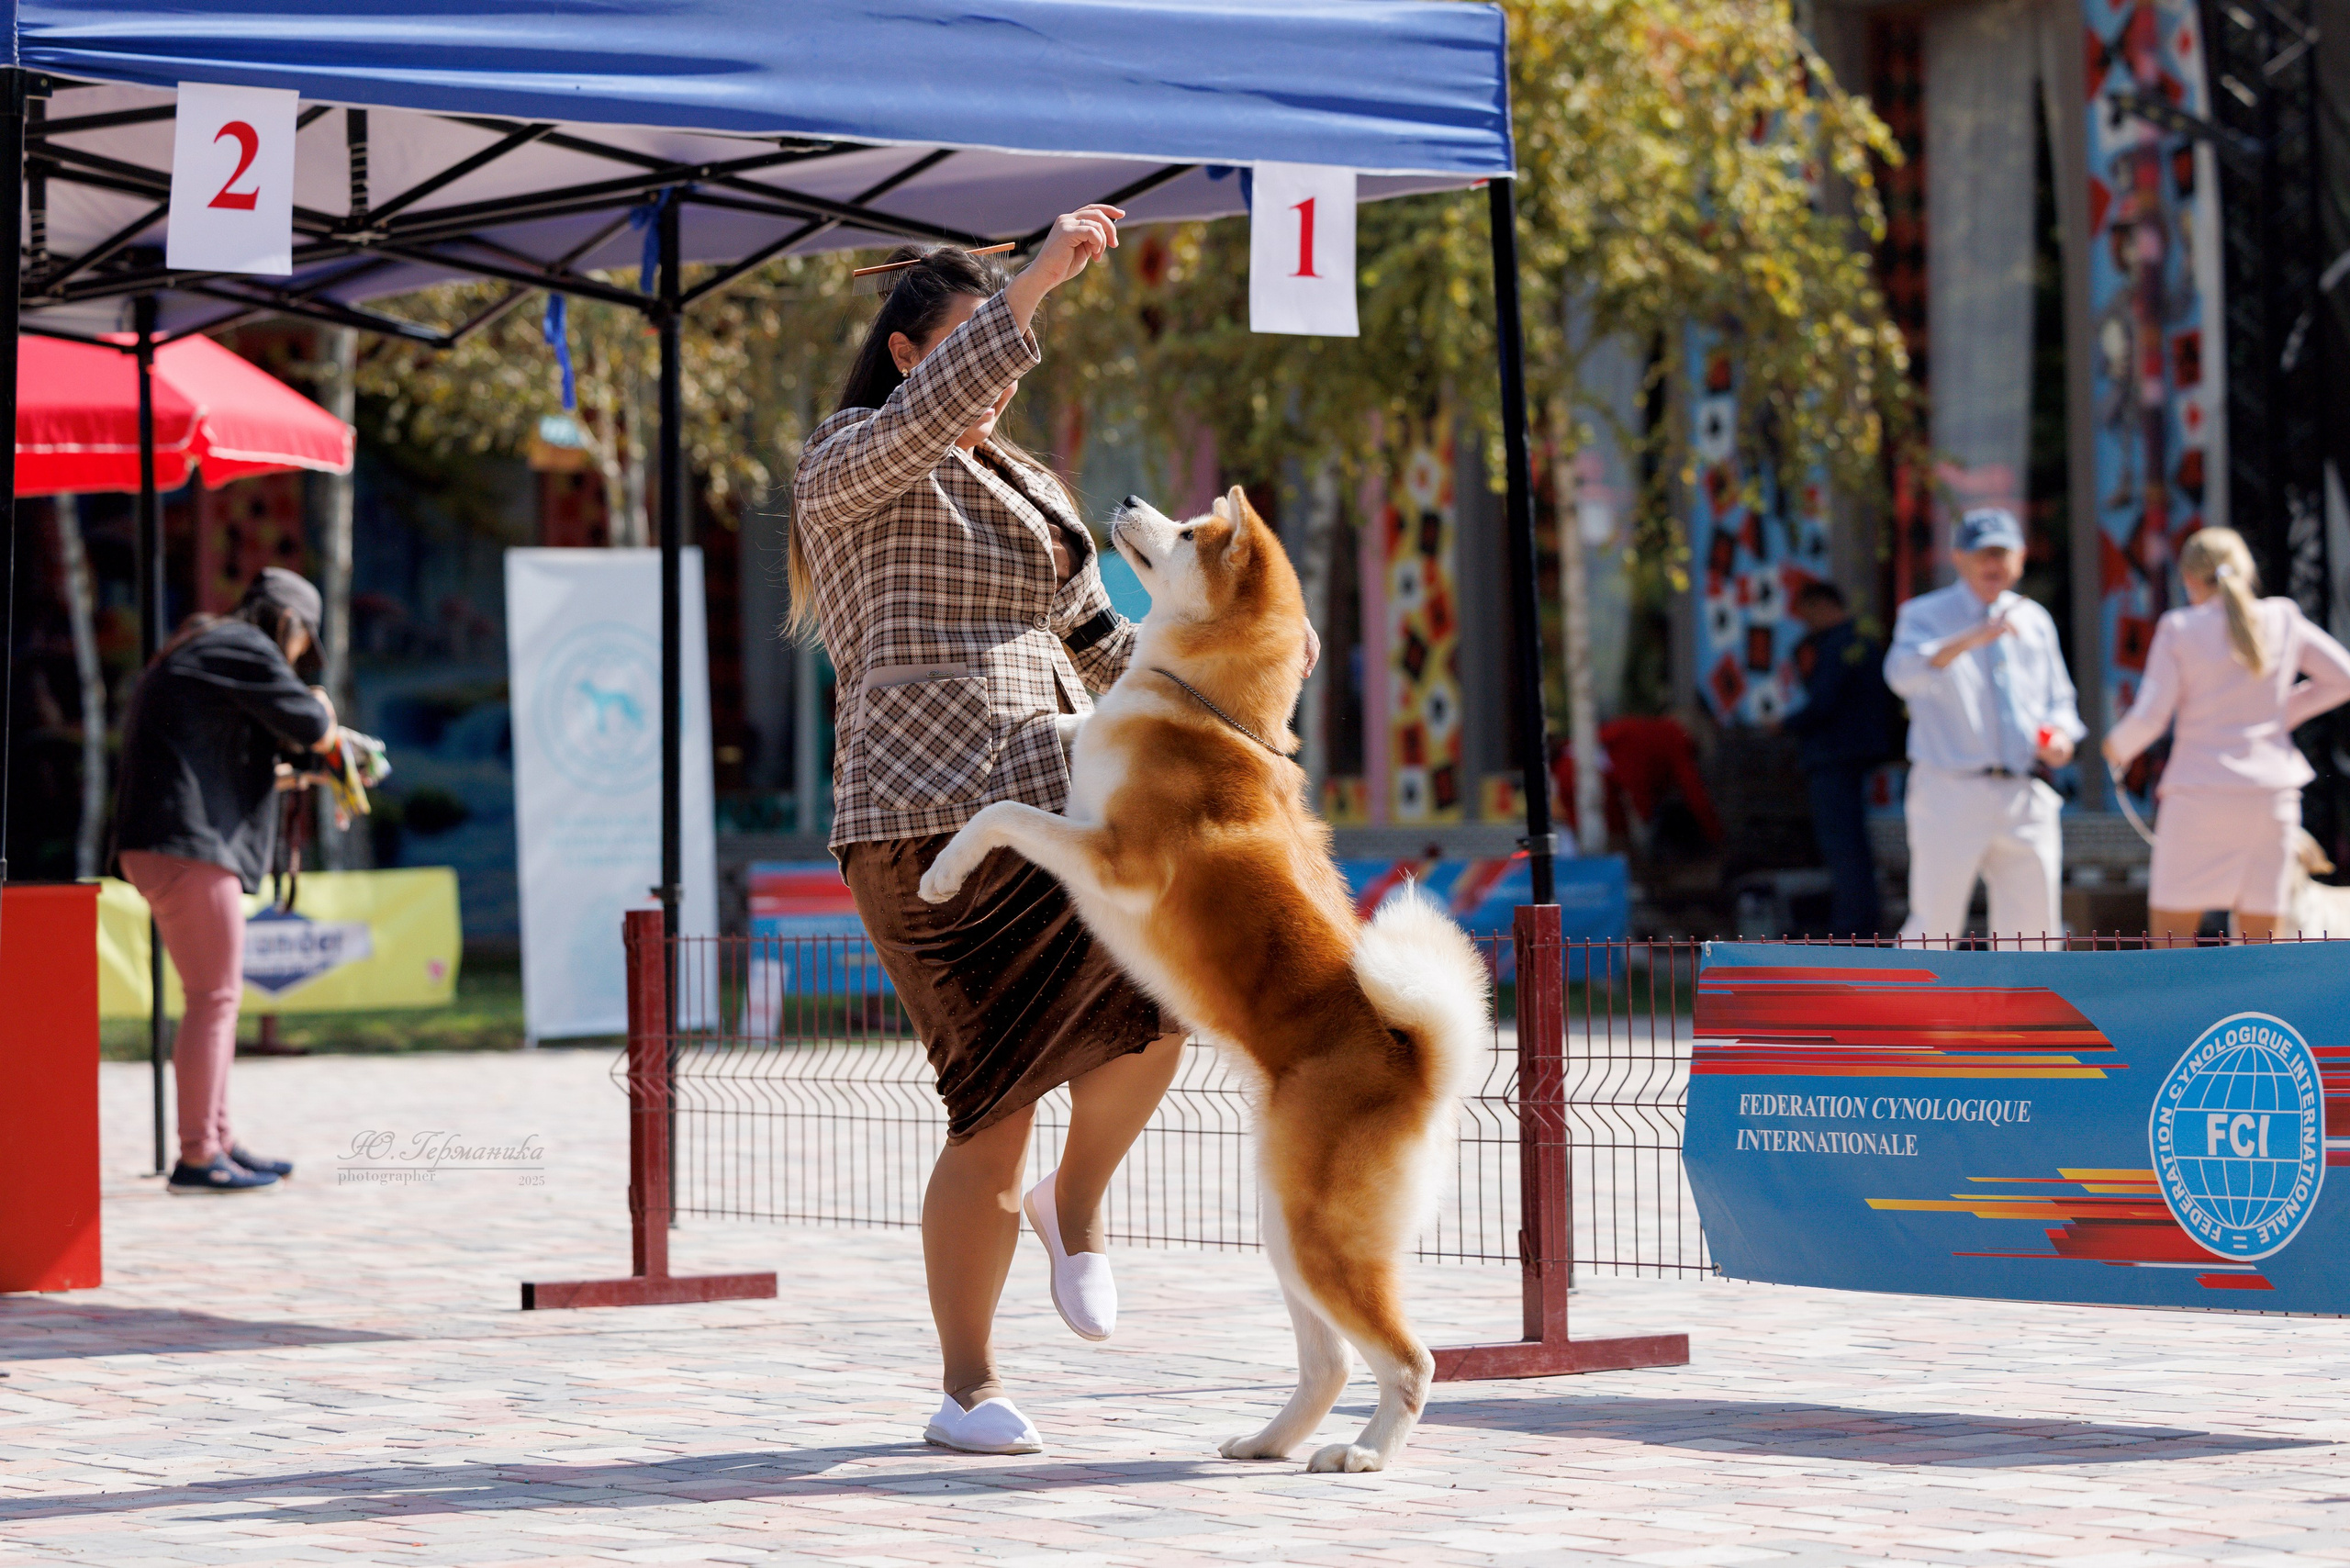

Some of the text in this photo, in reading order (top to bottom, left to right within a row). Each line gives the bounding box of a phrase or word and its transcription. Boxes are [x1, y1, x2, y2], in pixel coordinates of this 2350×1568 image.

[207, 120, 260, 210] 2
[1288, 196, 1324, 278] 1
[1739, 1093, 2031, 1126] FEDERATION CYNOLOGIQUE
[2157, 1025, 2316, 1245] FEDERATION CYNOLOGIQUE INTERNATIONALE
[2206, 1113, 2270, 1158] FCI
[1735, 1128, 1919, 1156] INTERNATIONALE
